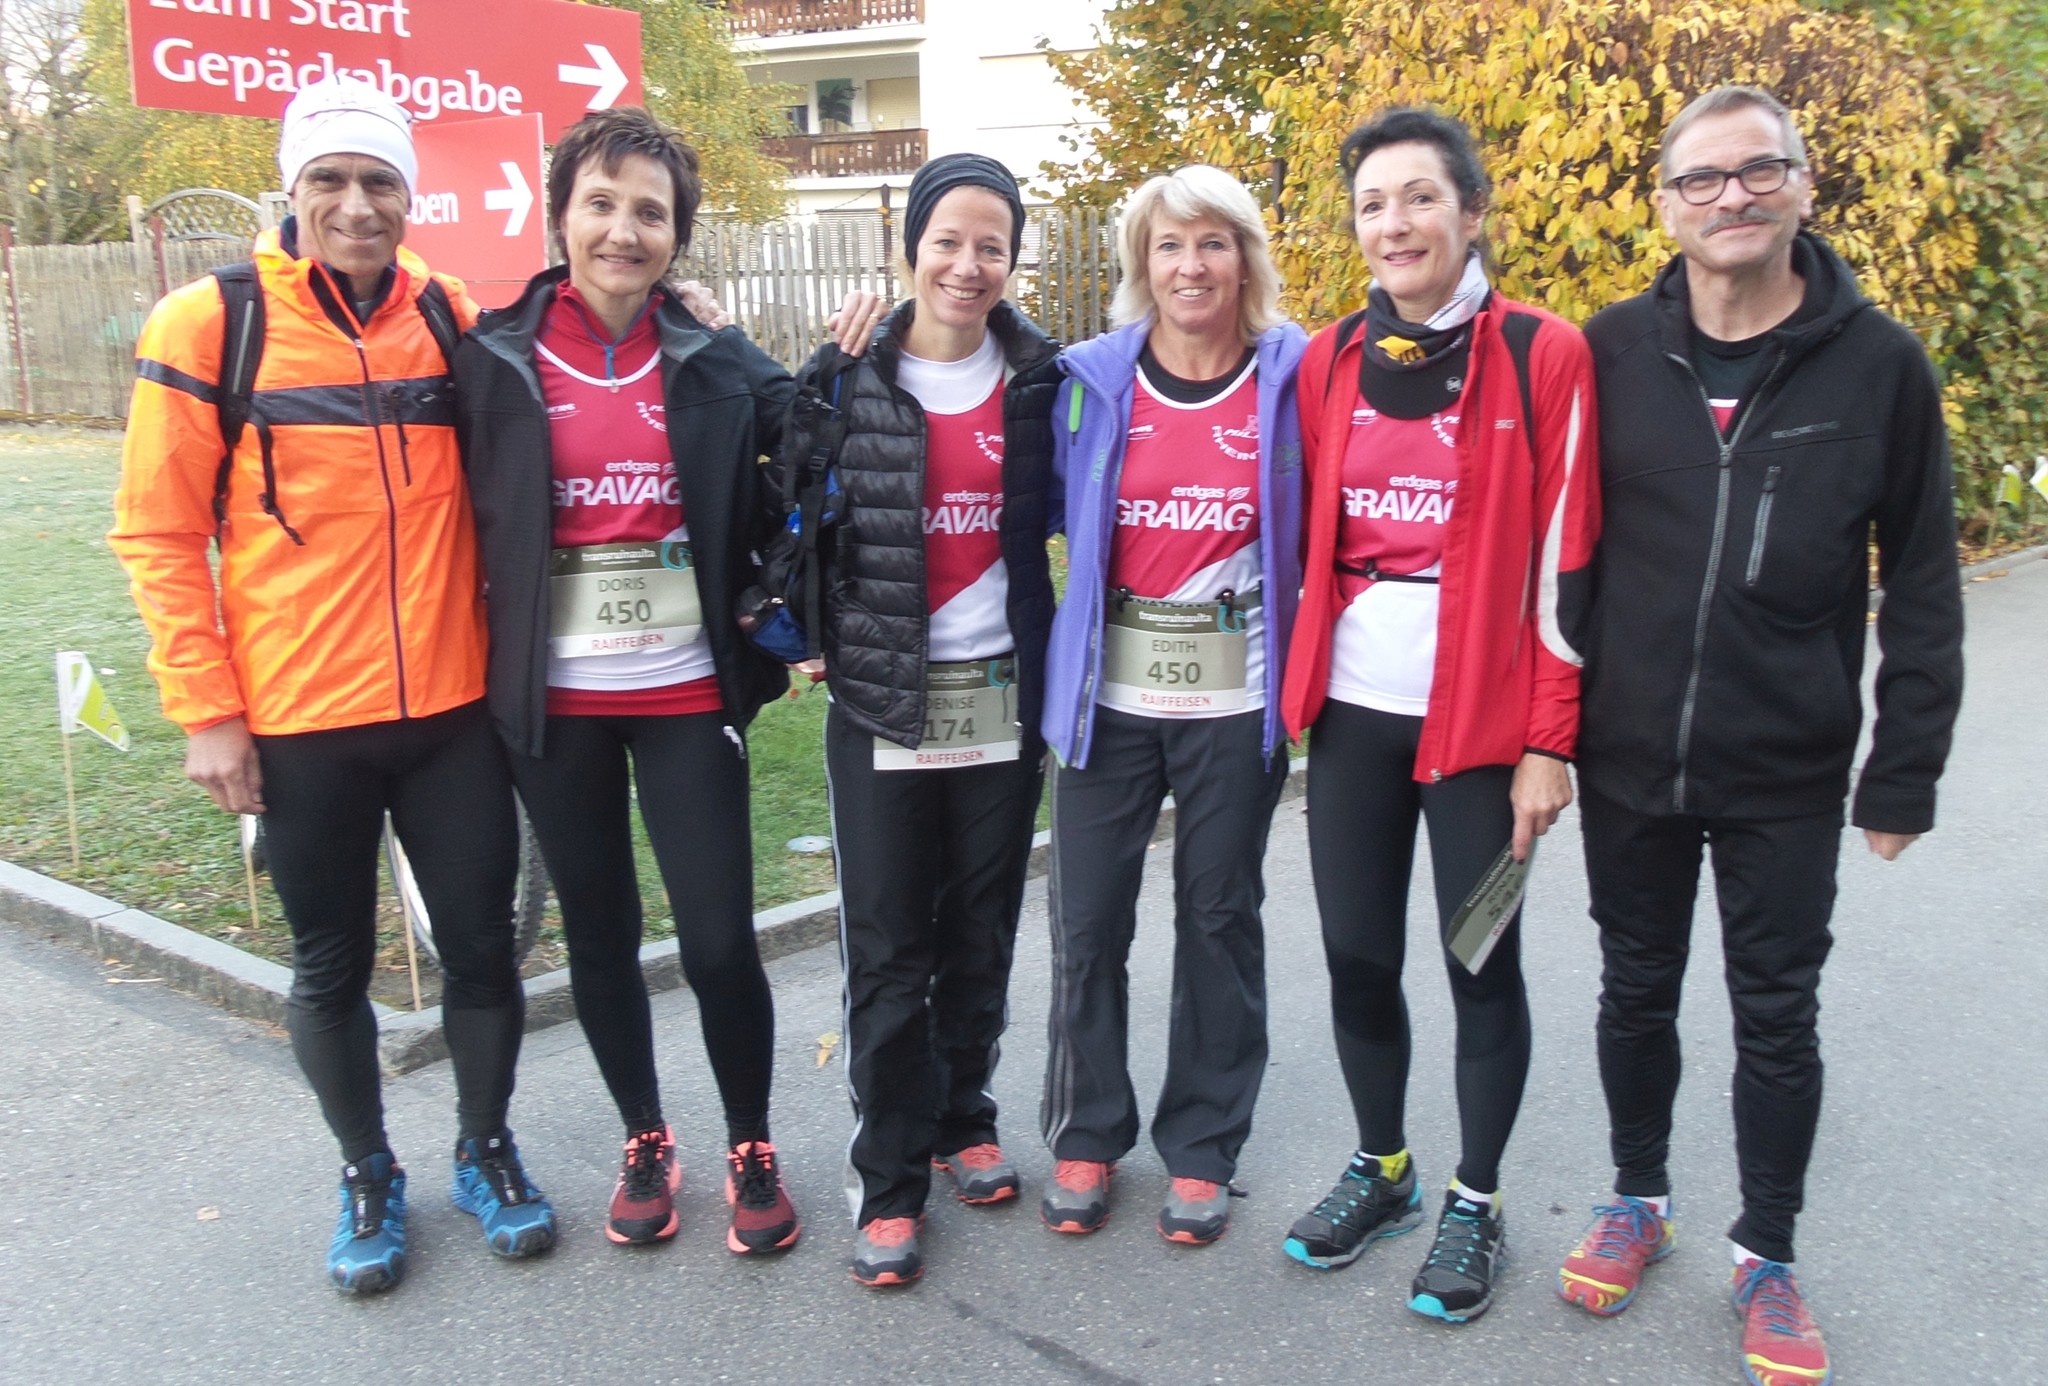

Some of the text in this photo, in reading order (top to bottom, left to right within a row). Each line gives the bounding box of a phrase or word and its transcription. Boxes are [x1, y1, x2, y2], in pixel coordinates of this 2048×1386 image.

[289, 0, 412, 38] Start
[605, 459, 661, 475] erdgas
[1388, 474, 1443, 491] erdgas
[942, 489, 991, 505] erdgas
[1170, 484, 1226, 500] erdgas
[1341, 486, 1455, 524] GRAVA
[1115, 498, 1255, 532] GRAVAG
[597, 576, 647, 593] DORIS
[596, 598, 652, 625] 450
[591, 633, 665, 651] RAIFFEISEN
[1151, 639, 1199, 654] EDITH
[1146, 660, 1201, 685] 450
[1140, 693, 1213, 708] RAIFFEISEN
[923, 717, 976, 742] 174
[915, 750, 985, 766] RAIFFEISEN
